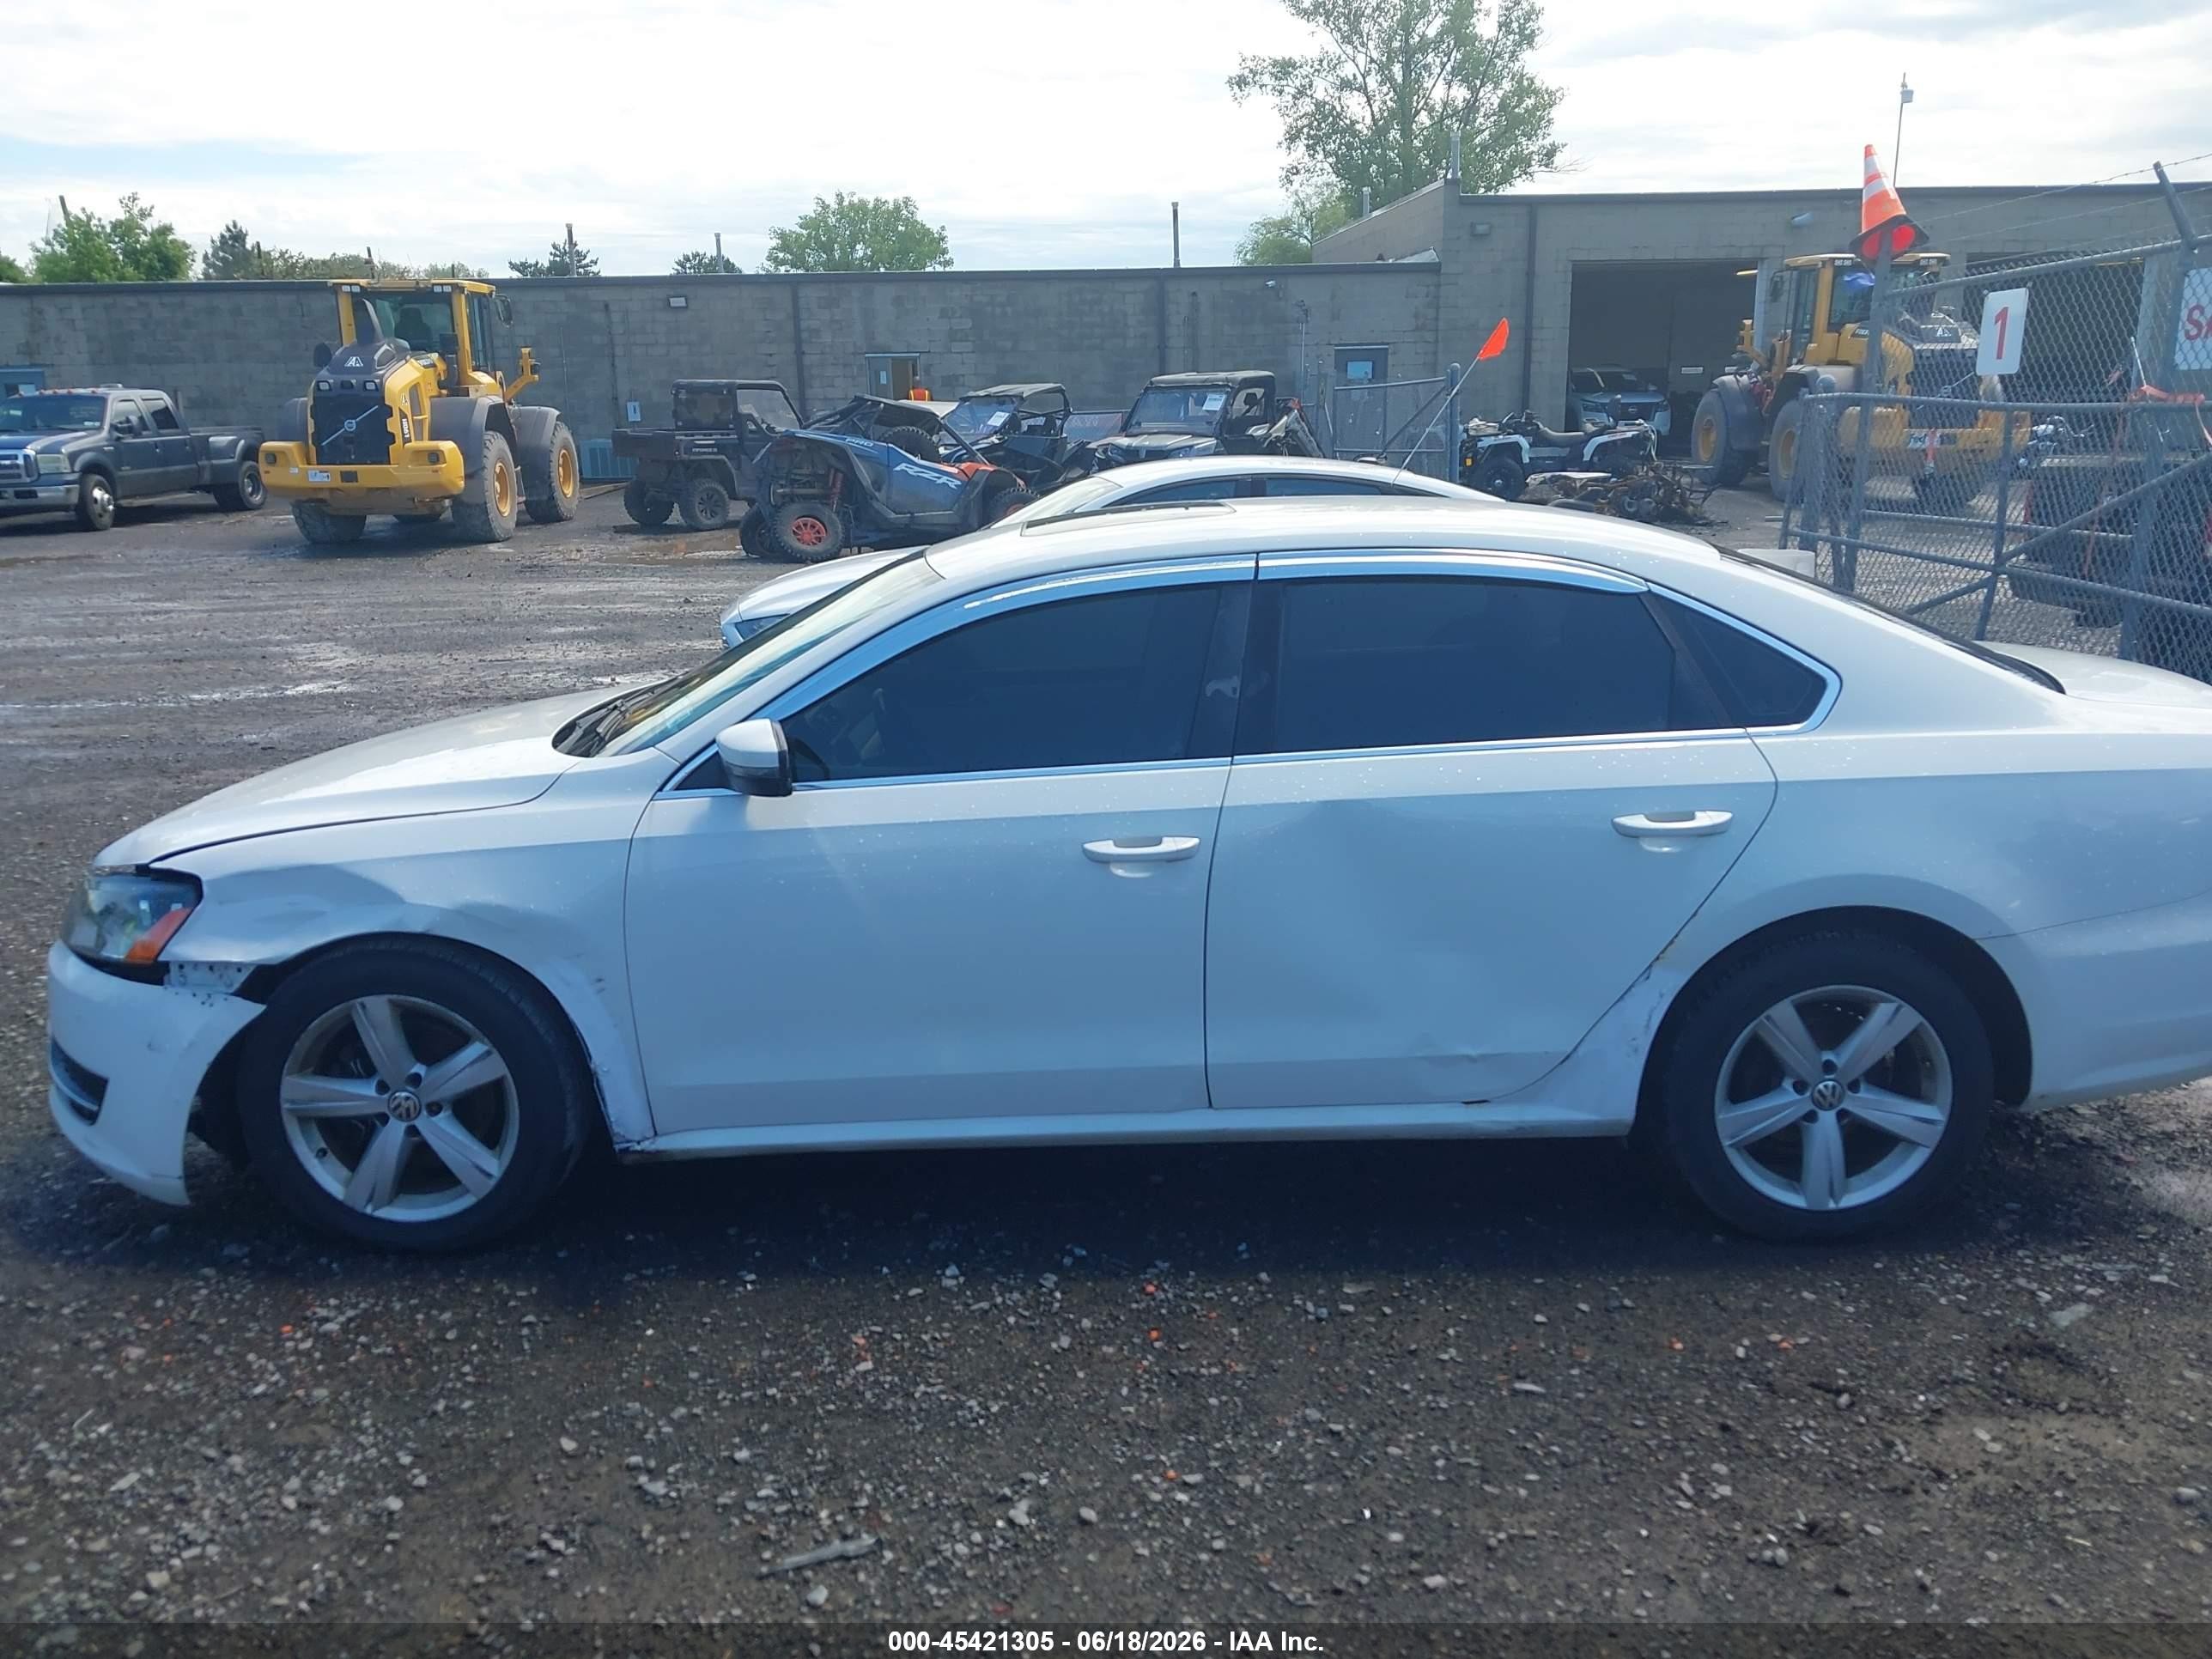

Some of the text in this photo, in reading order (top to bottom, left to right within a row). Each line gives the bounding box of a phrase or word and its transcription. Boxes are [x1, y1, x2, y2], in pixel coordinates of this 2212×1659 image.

[1994, 306, 2009, 360] 1
[845, 438, 874, 447] PRO
[893, 462, 963, 489] RZR
